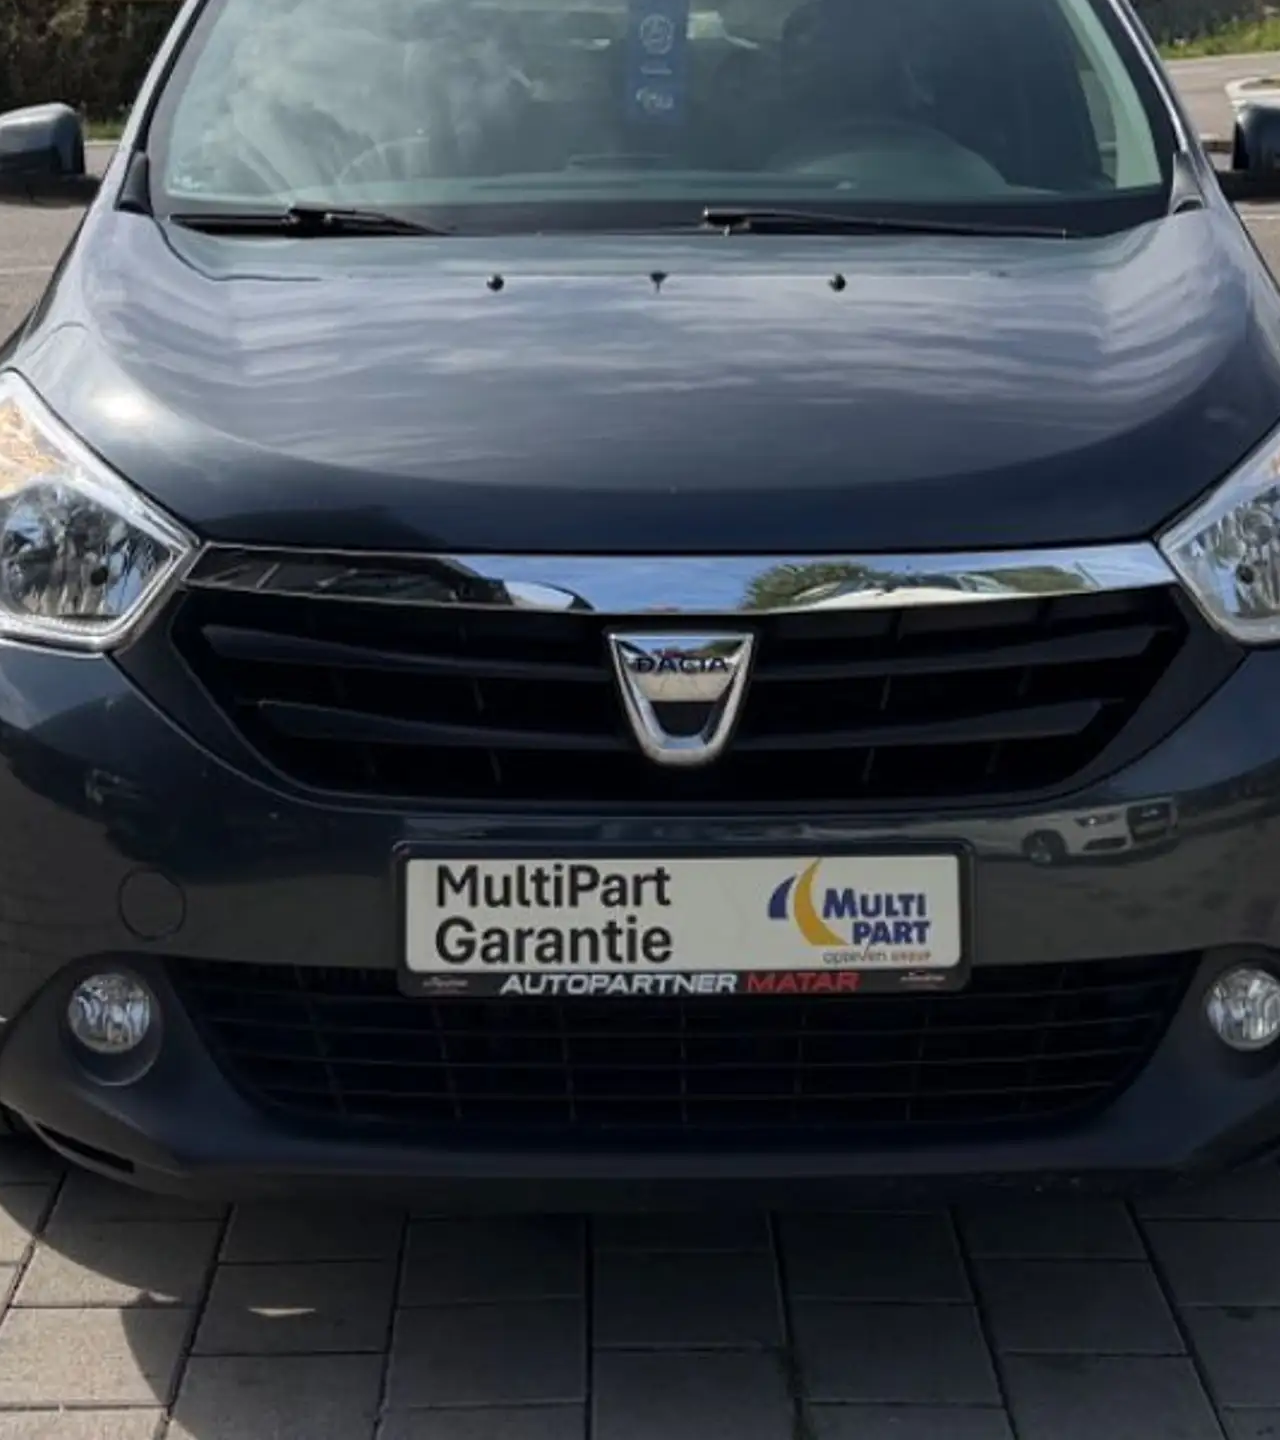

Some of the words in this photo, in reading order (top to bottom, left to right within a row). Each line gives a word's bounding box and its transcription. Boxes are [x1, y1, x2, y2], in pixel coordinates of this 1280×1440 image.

[636, 657, 729, 674] DACIA
[436, 863, 672, 909] MultiPart
[435, 914, 673, 965] Garantie
[852, 920, 931, 946] PART
[500, 973, 737, 995] AUTOPARTNER
[747, 971, 861, 994] MATAR
